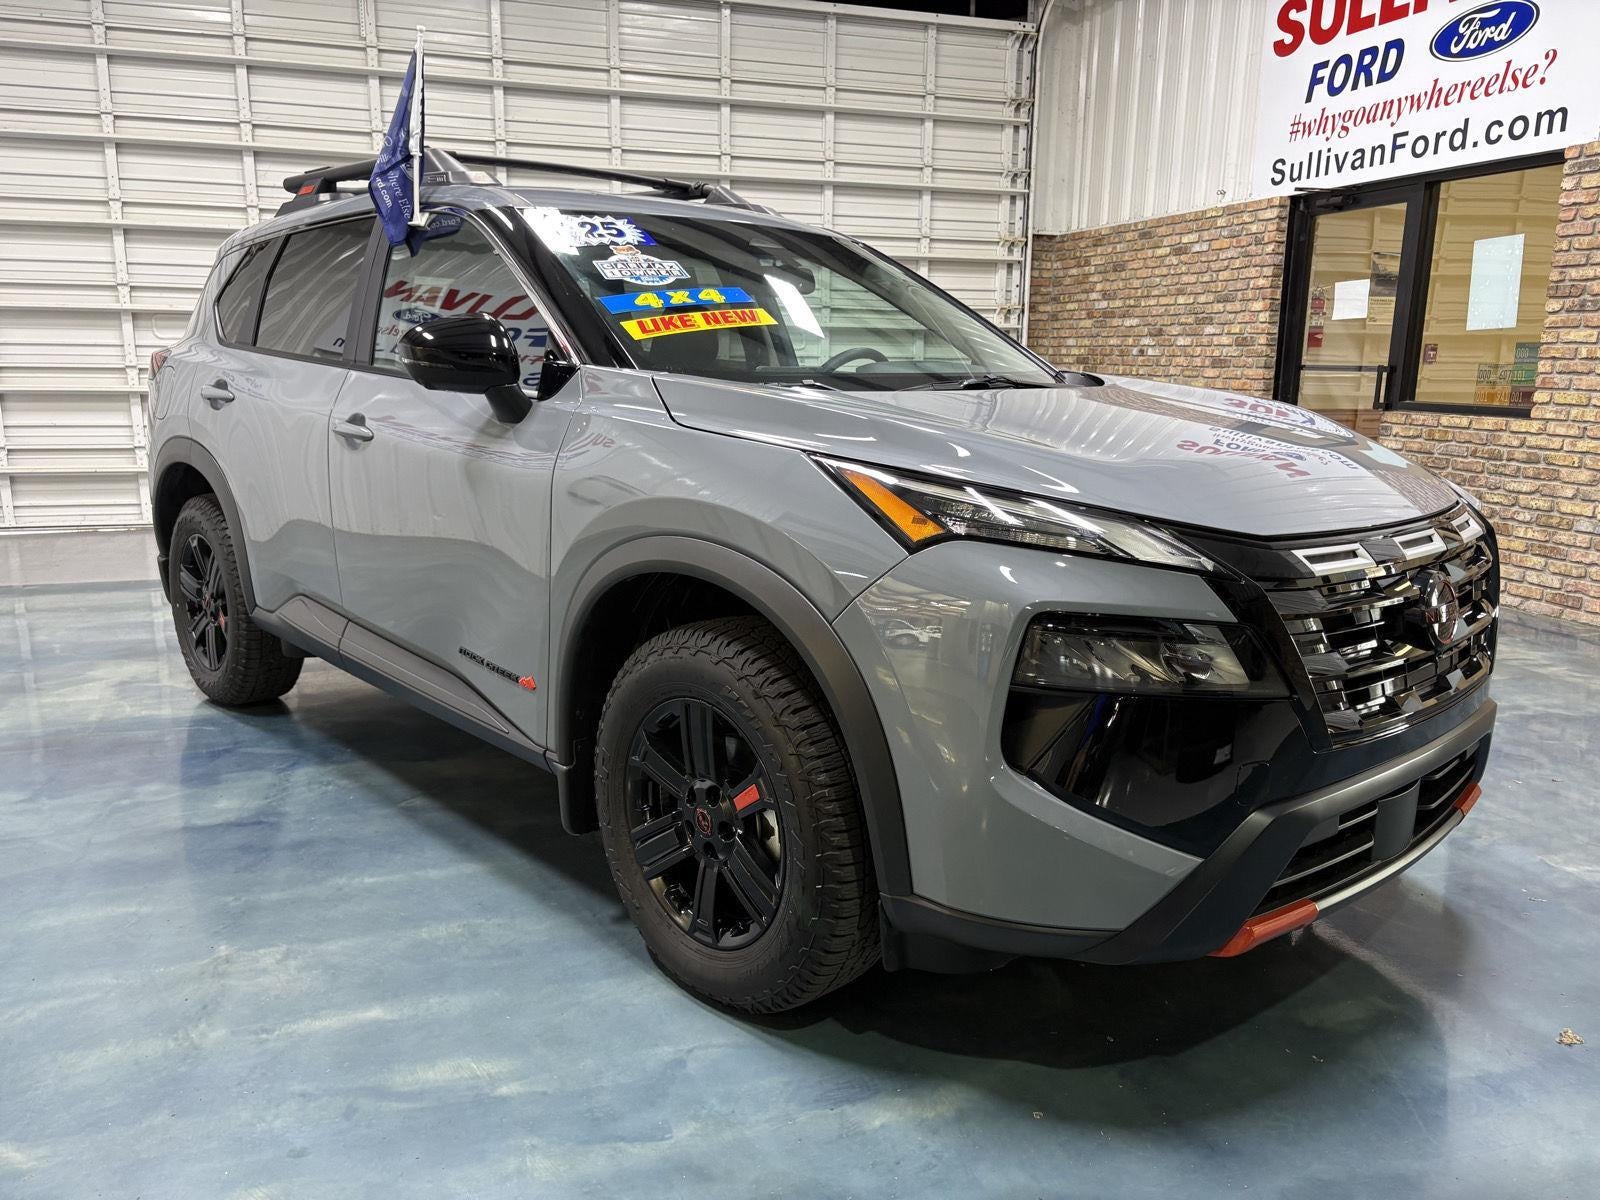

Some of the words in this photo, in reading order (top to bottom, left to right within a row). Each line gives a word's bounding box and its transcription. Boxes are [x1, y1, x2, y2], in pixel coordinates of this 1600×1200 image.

[1451, 6, 1513, 54] Ford
[1305, 37, 1405, 104] FORD
[1289, 48, 1557, 143] #whygoanywhereelse?
[1270, 106, 1568, 186] SullivanFord.com
[399, 198, 411, 219] Else
[578, 221, 627, 239] 25
[637, 314, 695, 335] LIKE
[704, 309, 758, 327] NEW
